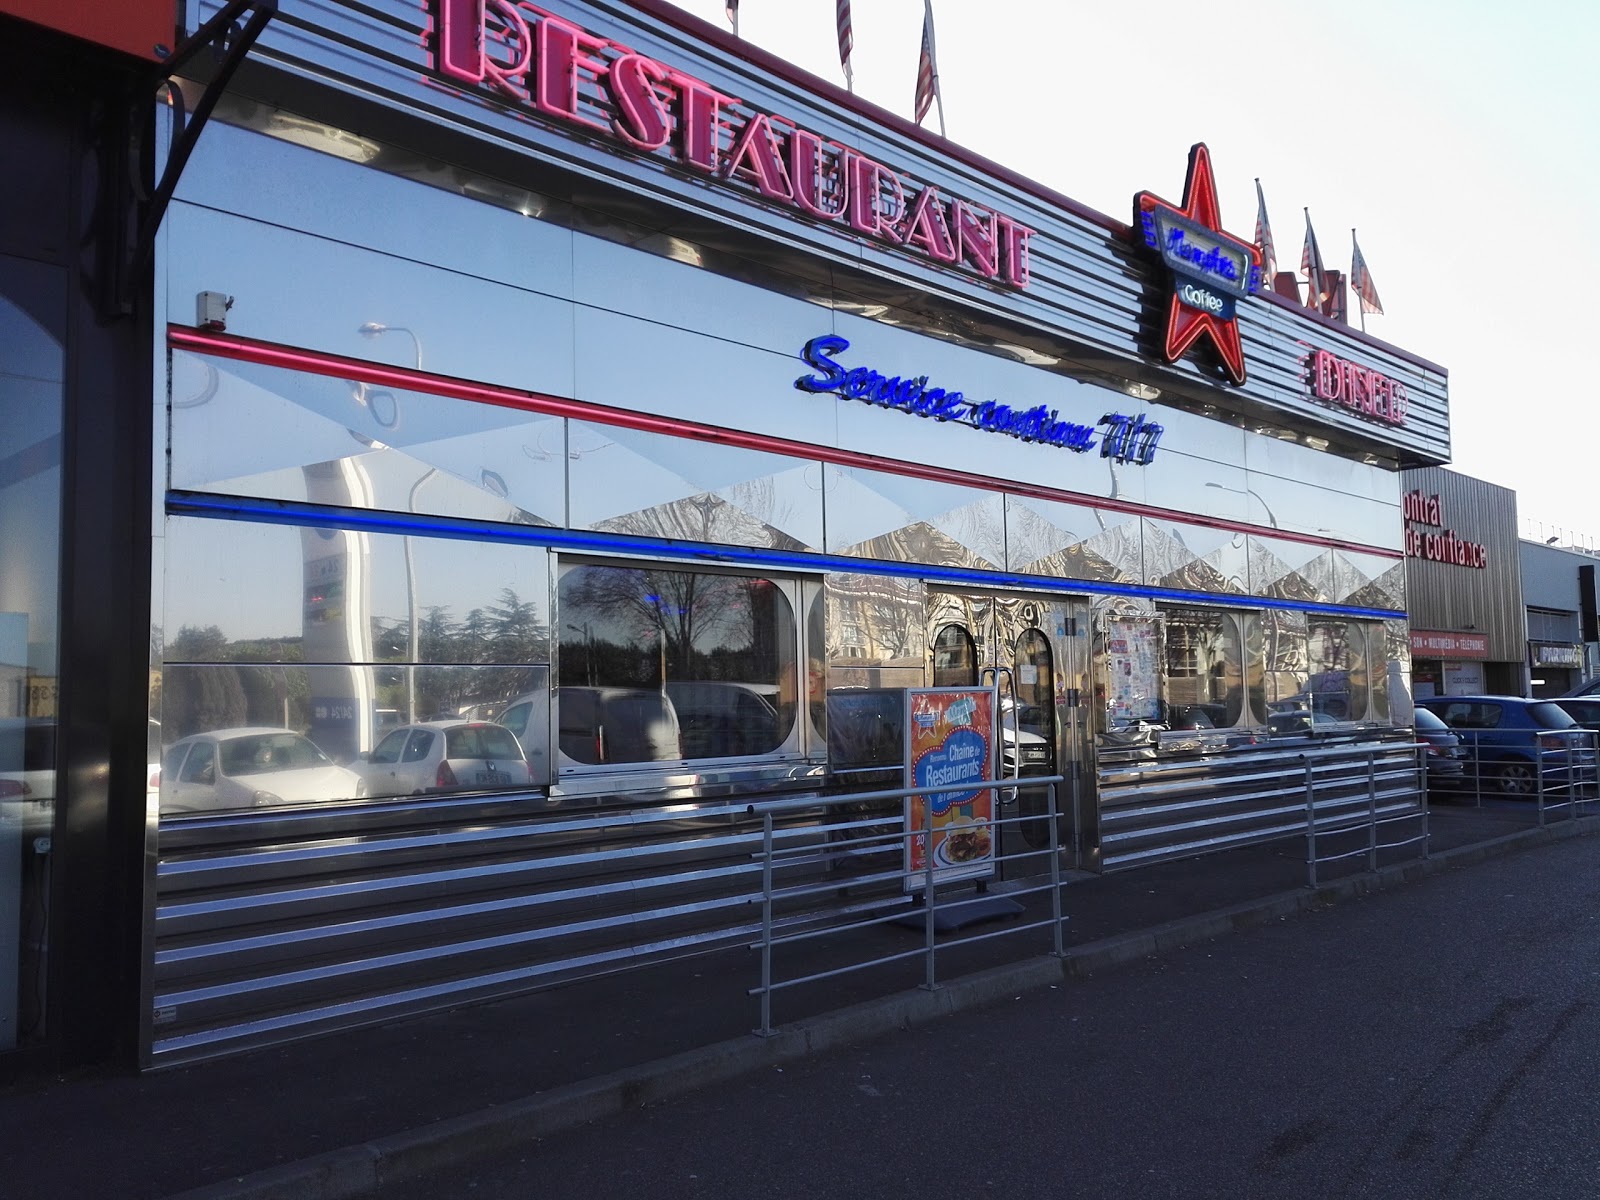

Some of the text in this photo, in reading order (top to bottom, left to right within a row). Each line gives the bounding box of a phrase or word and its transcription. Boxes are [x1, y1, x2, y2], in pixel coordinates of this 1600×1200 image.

[430, 0, 1038, 289] RESTAURANT
[1184, 284, 1224, 313] Coffee
[1314, 350, 1408, 425] DINER
[1405, 520, 1486, 568] de confiance
[1413, 636, 1423, 648] SON
[950, 742, 974, 762] Chaîne
[926, 759, 979, 787] Restaurants
